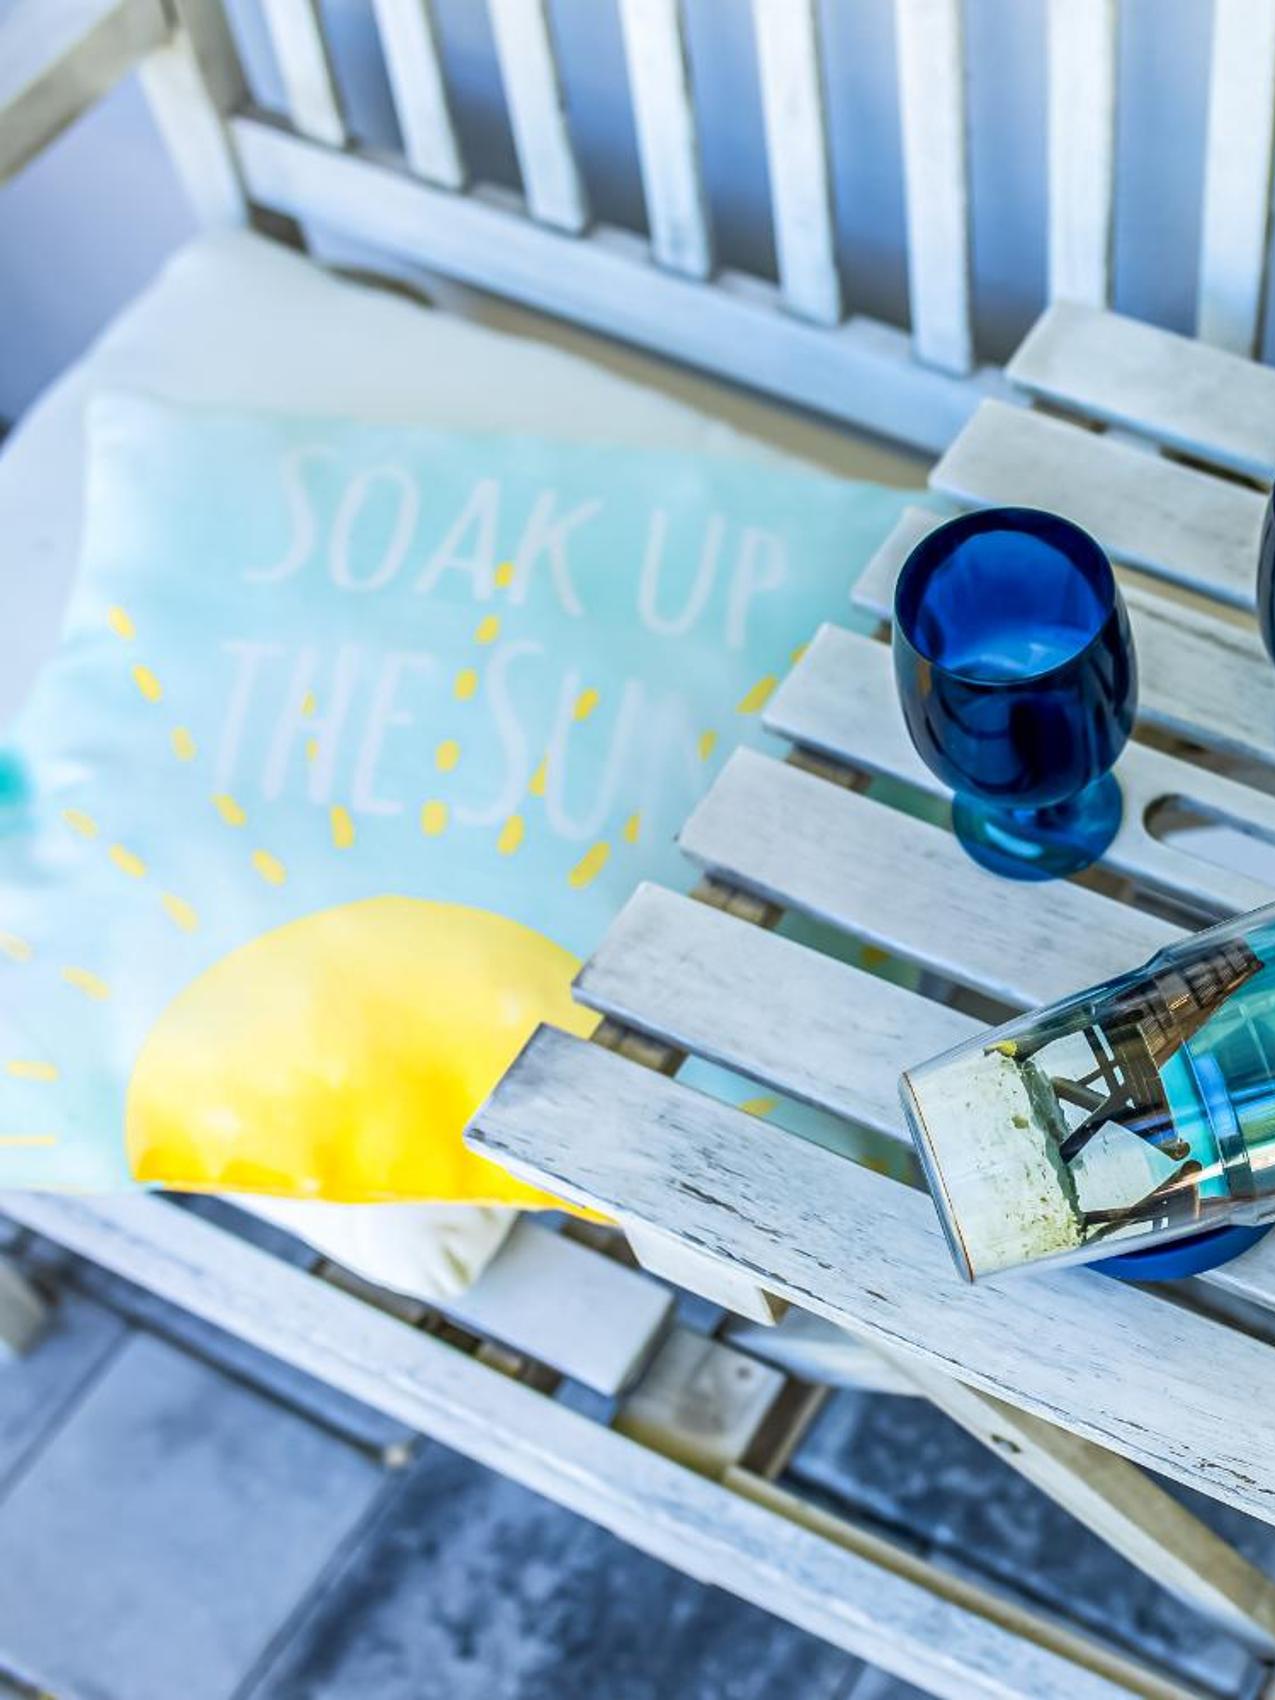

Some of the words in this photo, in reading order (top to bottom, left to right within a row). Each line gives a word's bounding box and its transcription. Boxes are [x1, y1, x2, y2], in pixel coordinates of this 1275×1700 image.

[244, 445, 601, 618] SOAK
[636, 506, 788, 650] UP
[211, 639, 438, 815] THE
